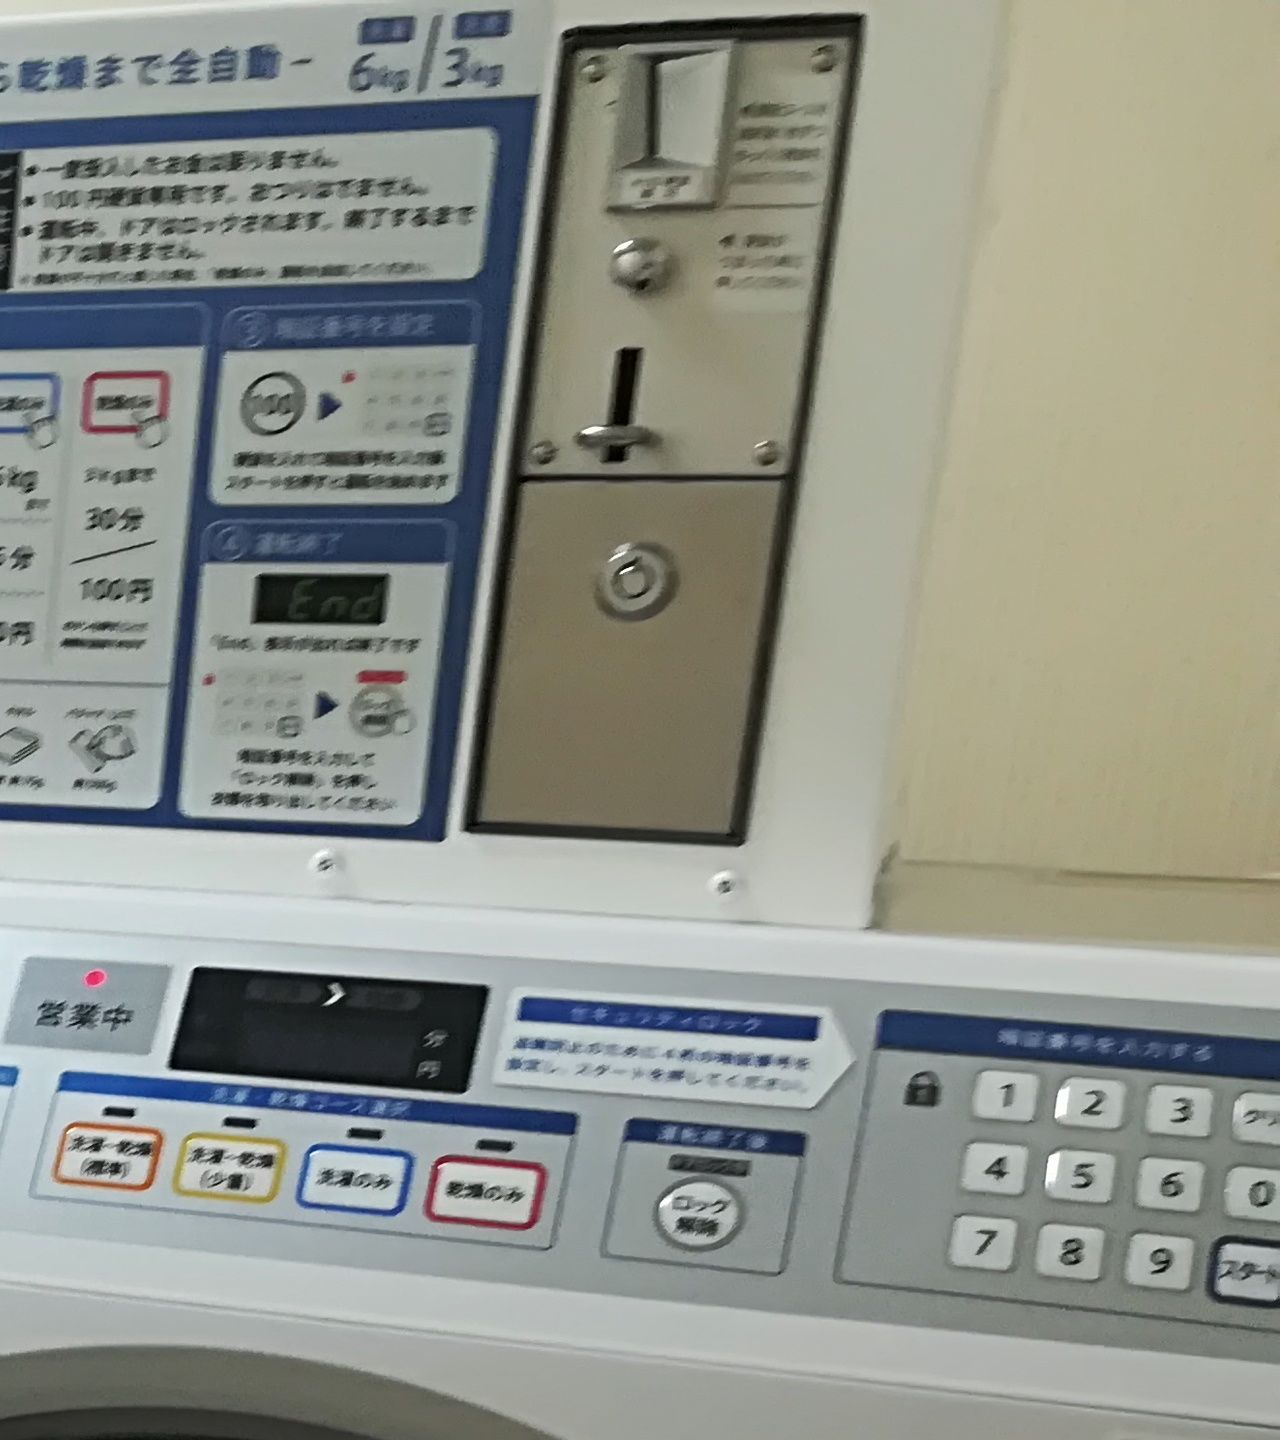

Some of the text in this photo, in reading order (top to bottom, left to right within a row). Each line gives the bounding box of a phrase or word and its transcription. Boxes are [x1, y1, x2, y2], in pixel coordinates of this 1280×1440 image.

[34, 999, 136, 1033] 営業中
[998, 1082, 1017, 1109] 1
[1079, 1088, 1108, 1117] 2
[1168, 1096, 1195, 1124] 3
[983, 1155, 1010, 1182] 4
[1070, 1162, 1097, 1190] 5
[1158, 1170, 1185, 1199] 6
[1247, 1178, 1278, 1209] 0
[973, 1228, 999, 1257] 7
[1058, 1236, 1087, 1267] 8
[1149, 1245, 1177, 1275] 9
